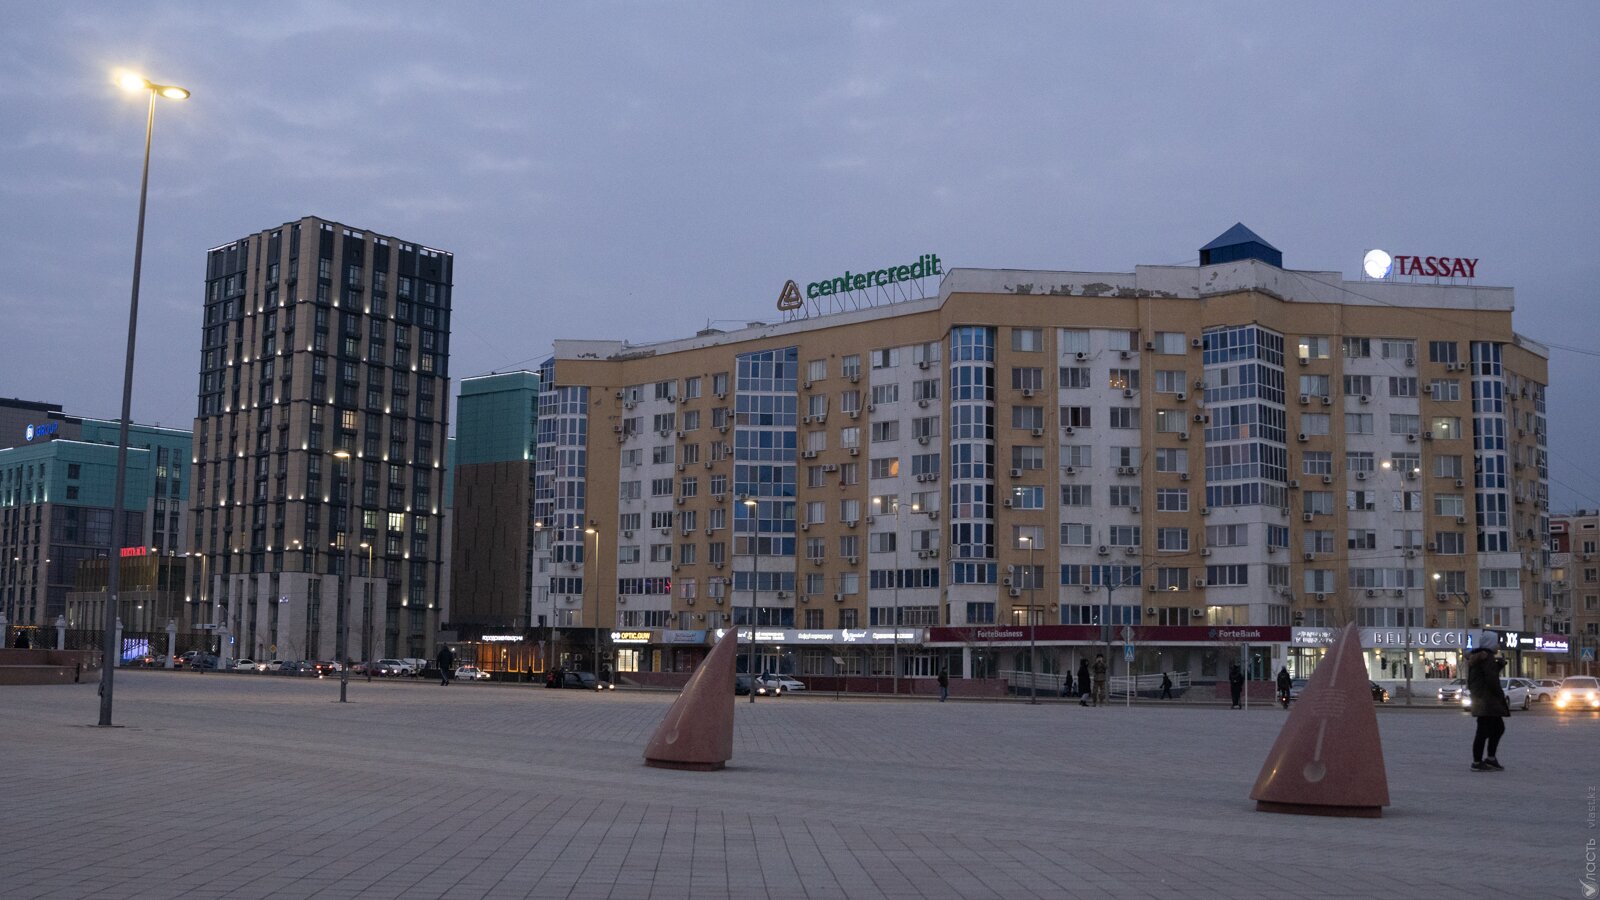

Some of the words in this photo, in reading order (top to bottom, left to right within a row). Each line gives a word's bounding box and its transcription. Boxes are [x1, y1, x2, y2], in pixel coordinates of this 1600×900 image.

[807, 253, 942, 299] centercredit
[1394, 255, 1479, 278] TASSAY
[1218, 630, 1261, 638] ForteBank
[1373, 631, 1463, 646] BELLUCCI
